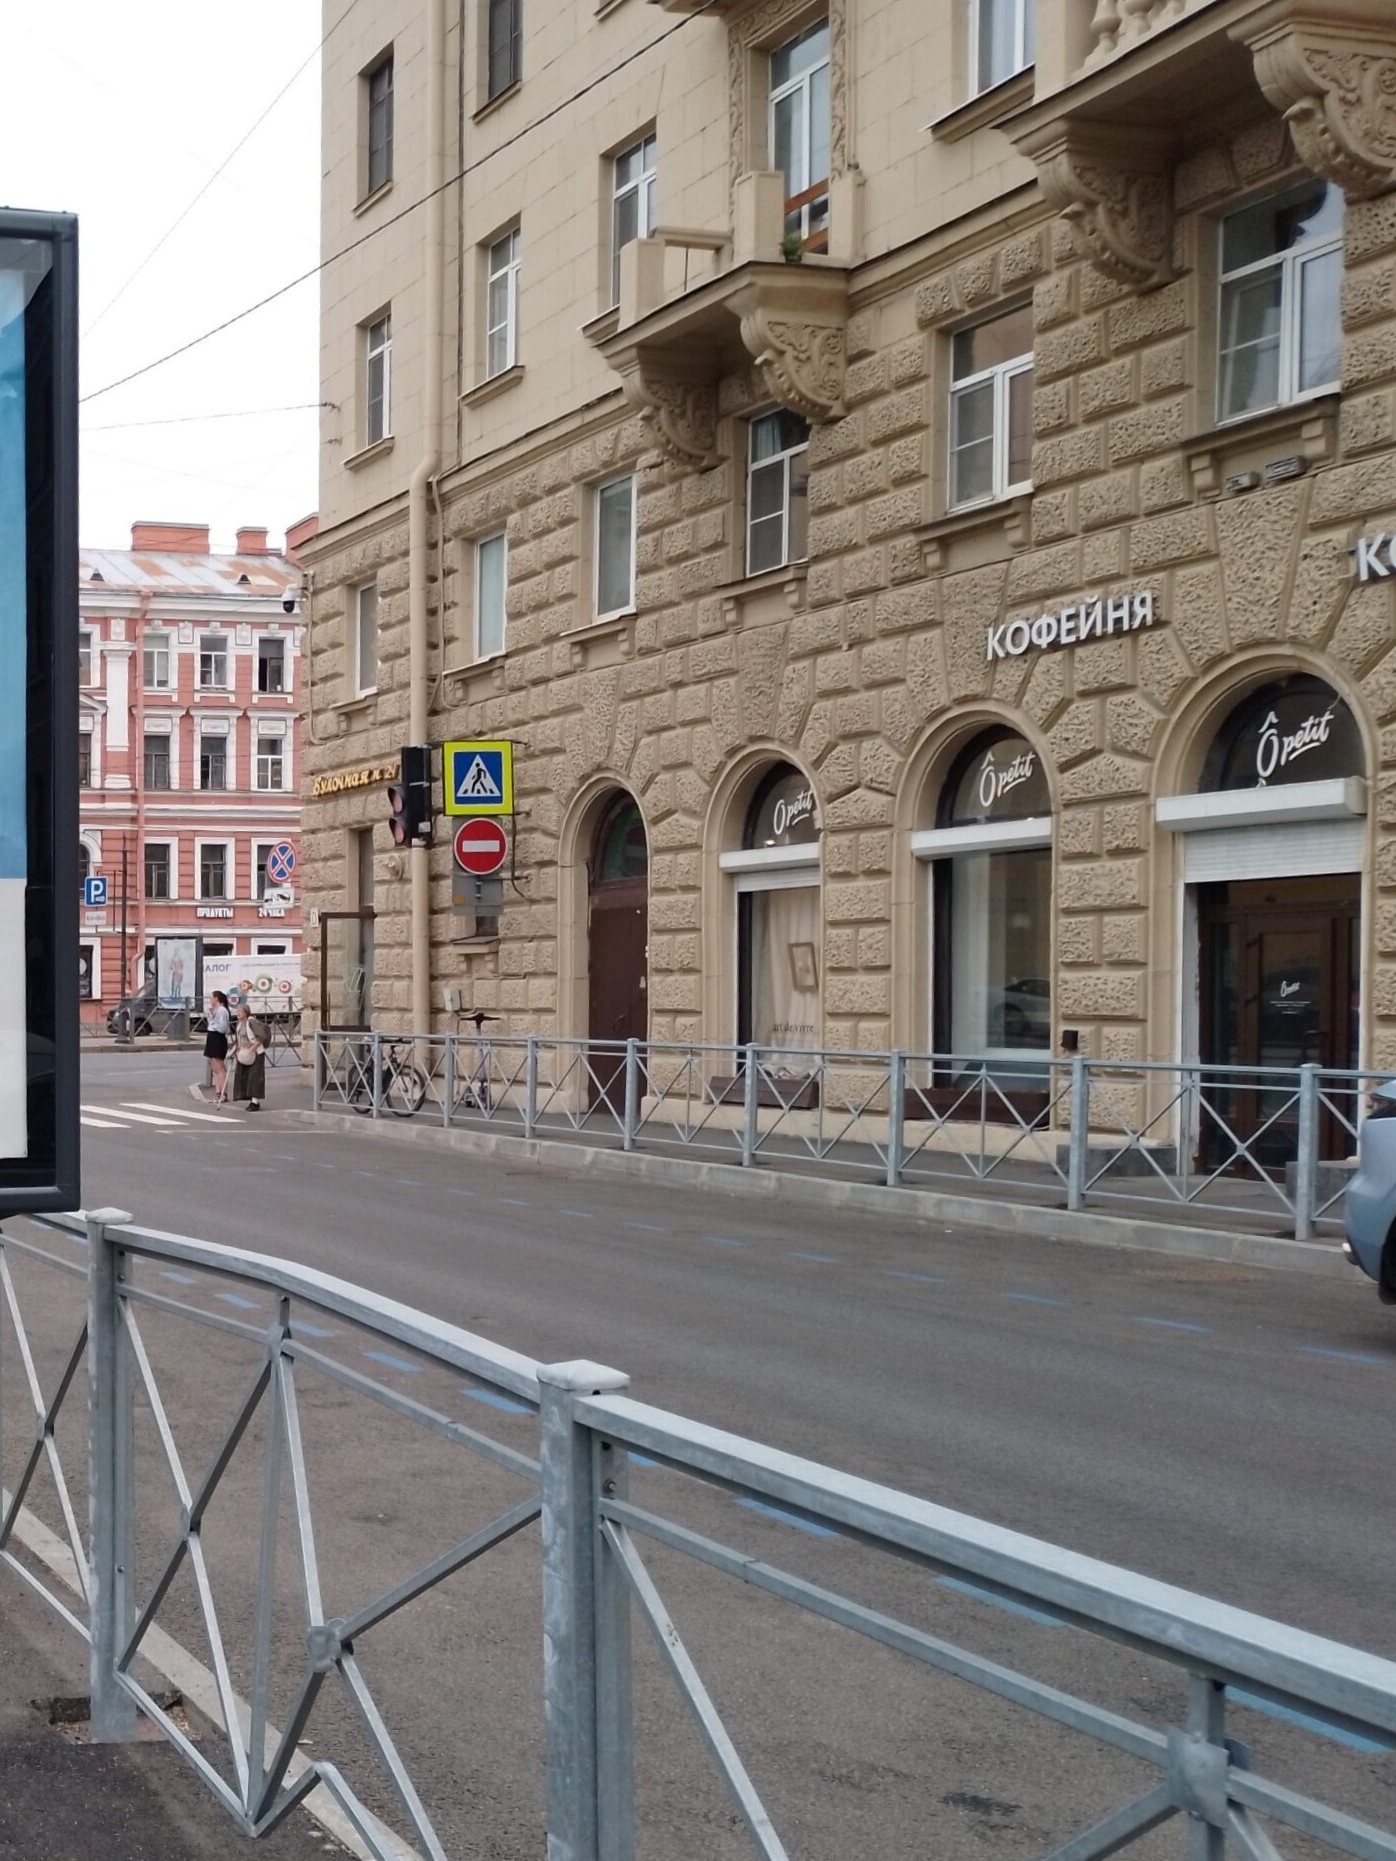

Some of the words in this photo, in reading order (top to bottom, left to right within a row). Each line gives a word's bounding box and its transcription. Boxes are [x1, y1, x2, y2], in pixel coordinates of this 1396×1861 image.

[986, 590, 1154, 661] КОФЕЙНЯ
[312, 770, 370, 795] Булочная
[196, 907, 234, 918] ПРОДУКТЫ
